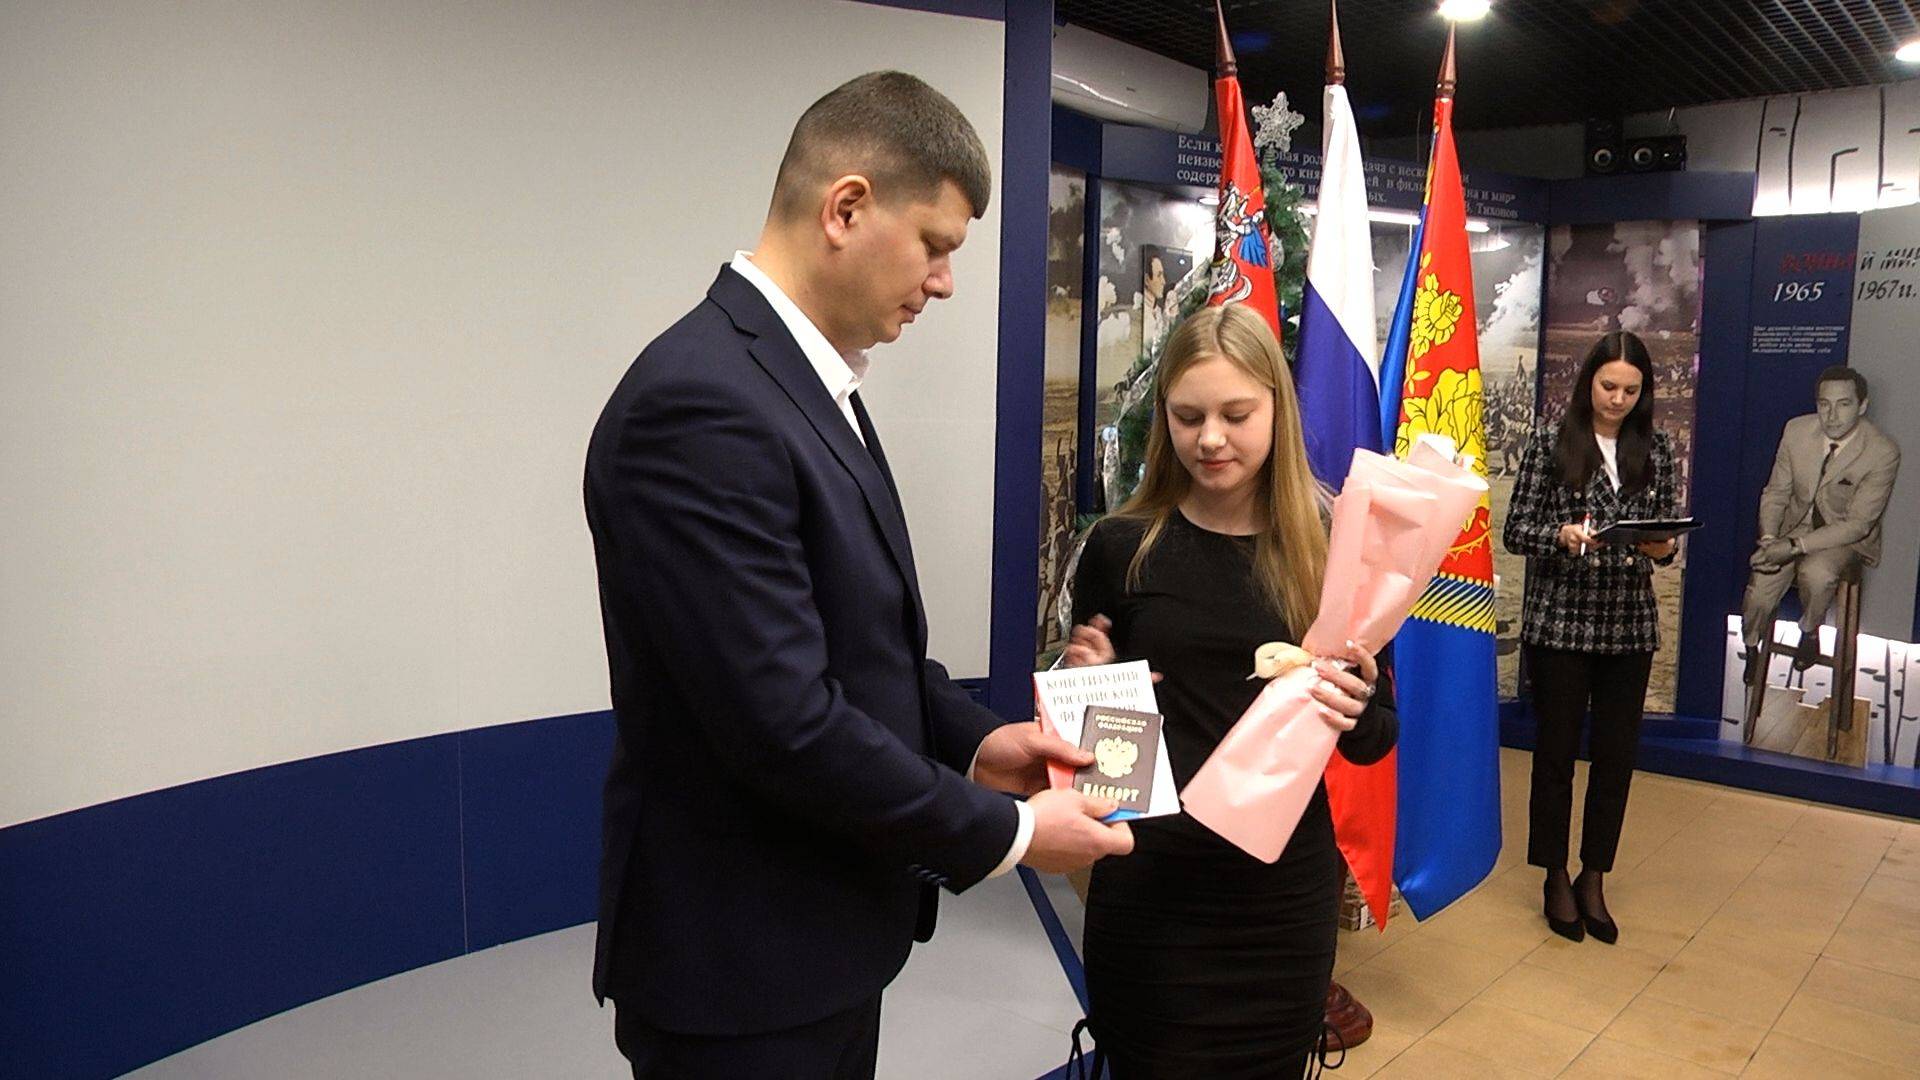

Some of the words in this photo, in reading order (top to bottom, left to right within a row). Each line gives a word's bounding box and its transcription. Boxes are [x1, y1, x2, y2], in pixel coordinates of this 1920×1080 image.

[1178, 135, 1211, 150] Если
[1774, 281, 1825, 303] 1965
[1083, 782, 1140, 802] ПАСПОРТ
